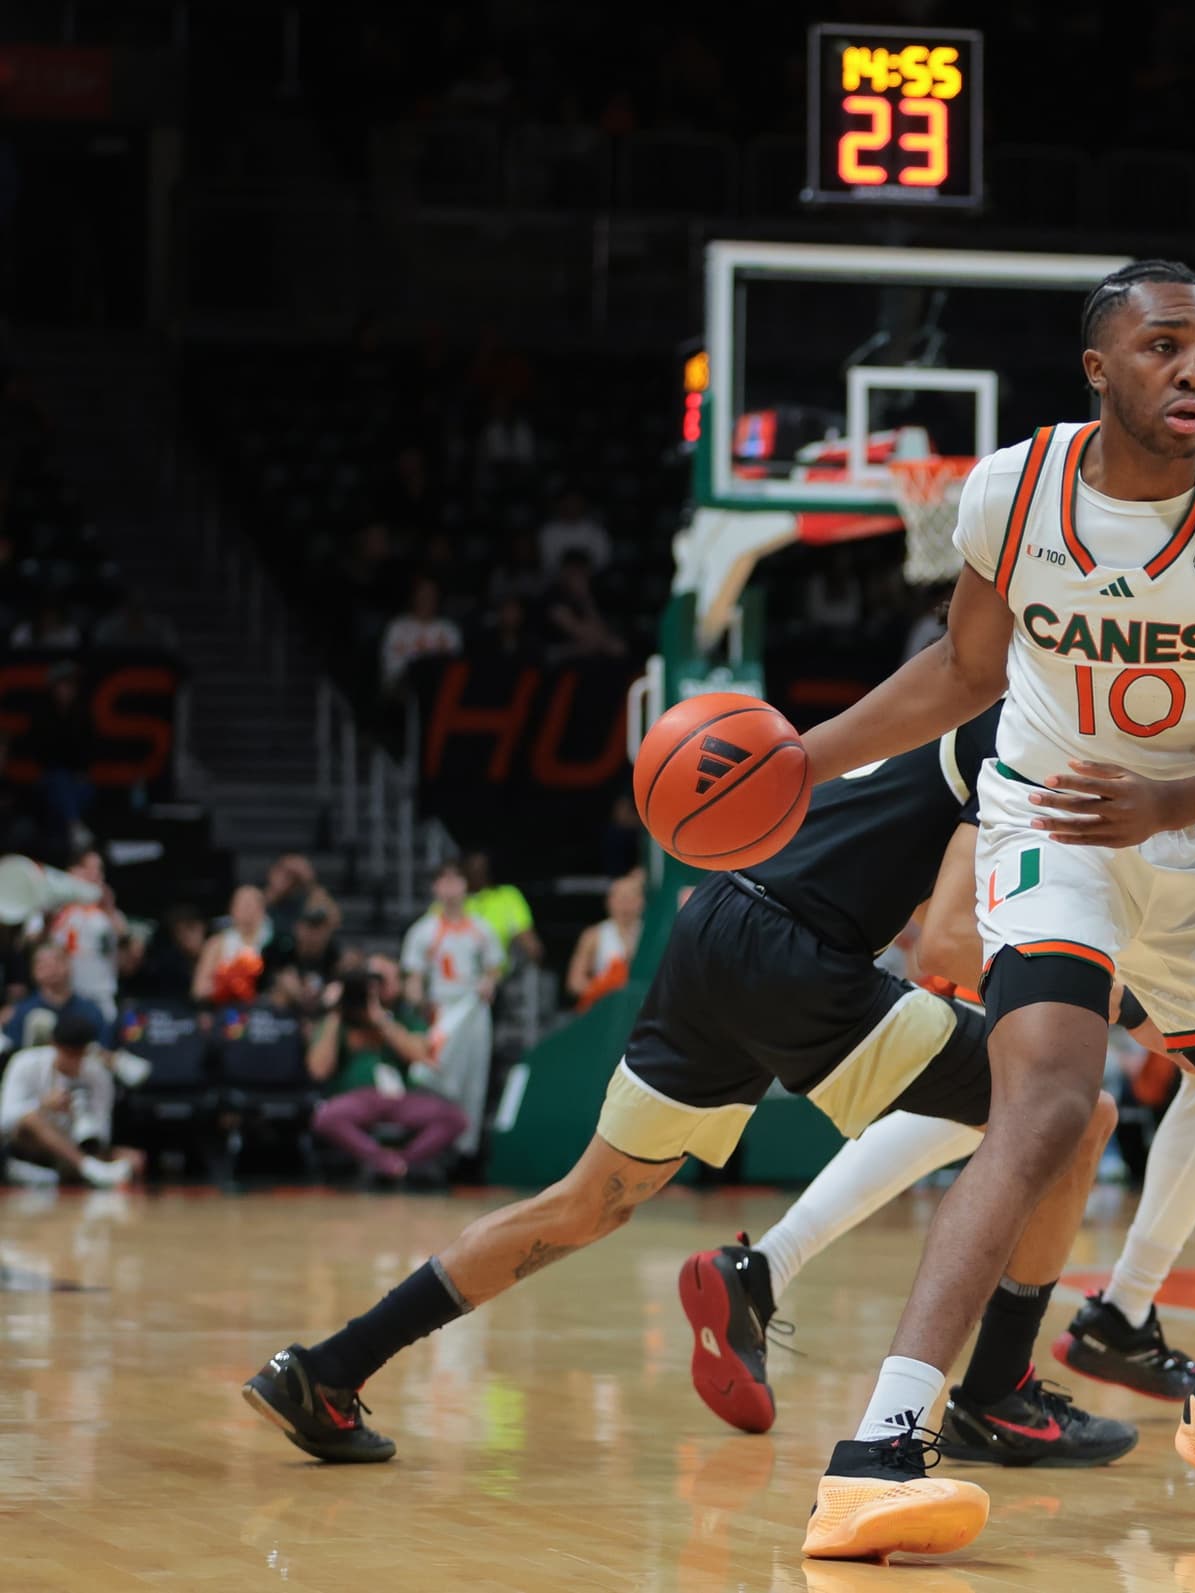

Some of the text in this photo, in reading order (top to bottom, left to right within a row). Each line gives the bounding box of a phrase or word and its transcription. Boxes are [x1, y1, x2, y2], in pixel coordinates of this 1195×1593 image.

[842, 45, 964, 100] 14:55
[837, 95, 949, 186] 23
[1046, 549, 1066, 566] 100
[1074, 664, 1186, 738] 10
